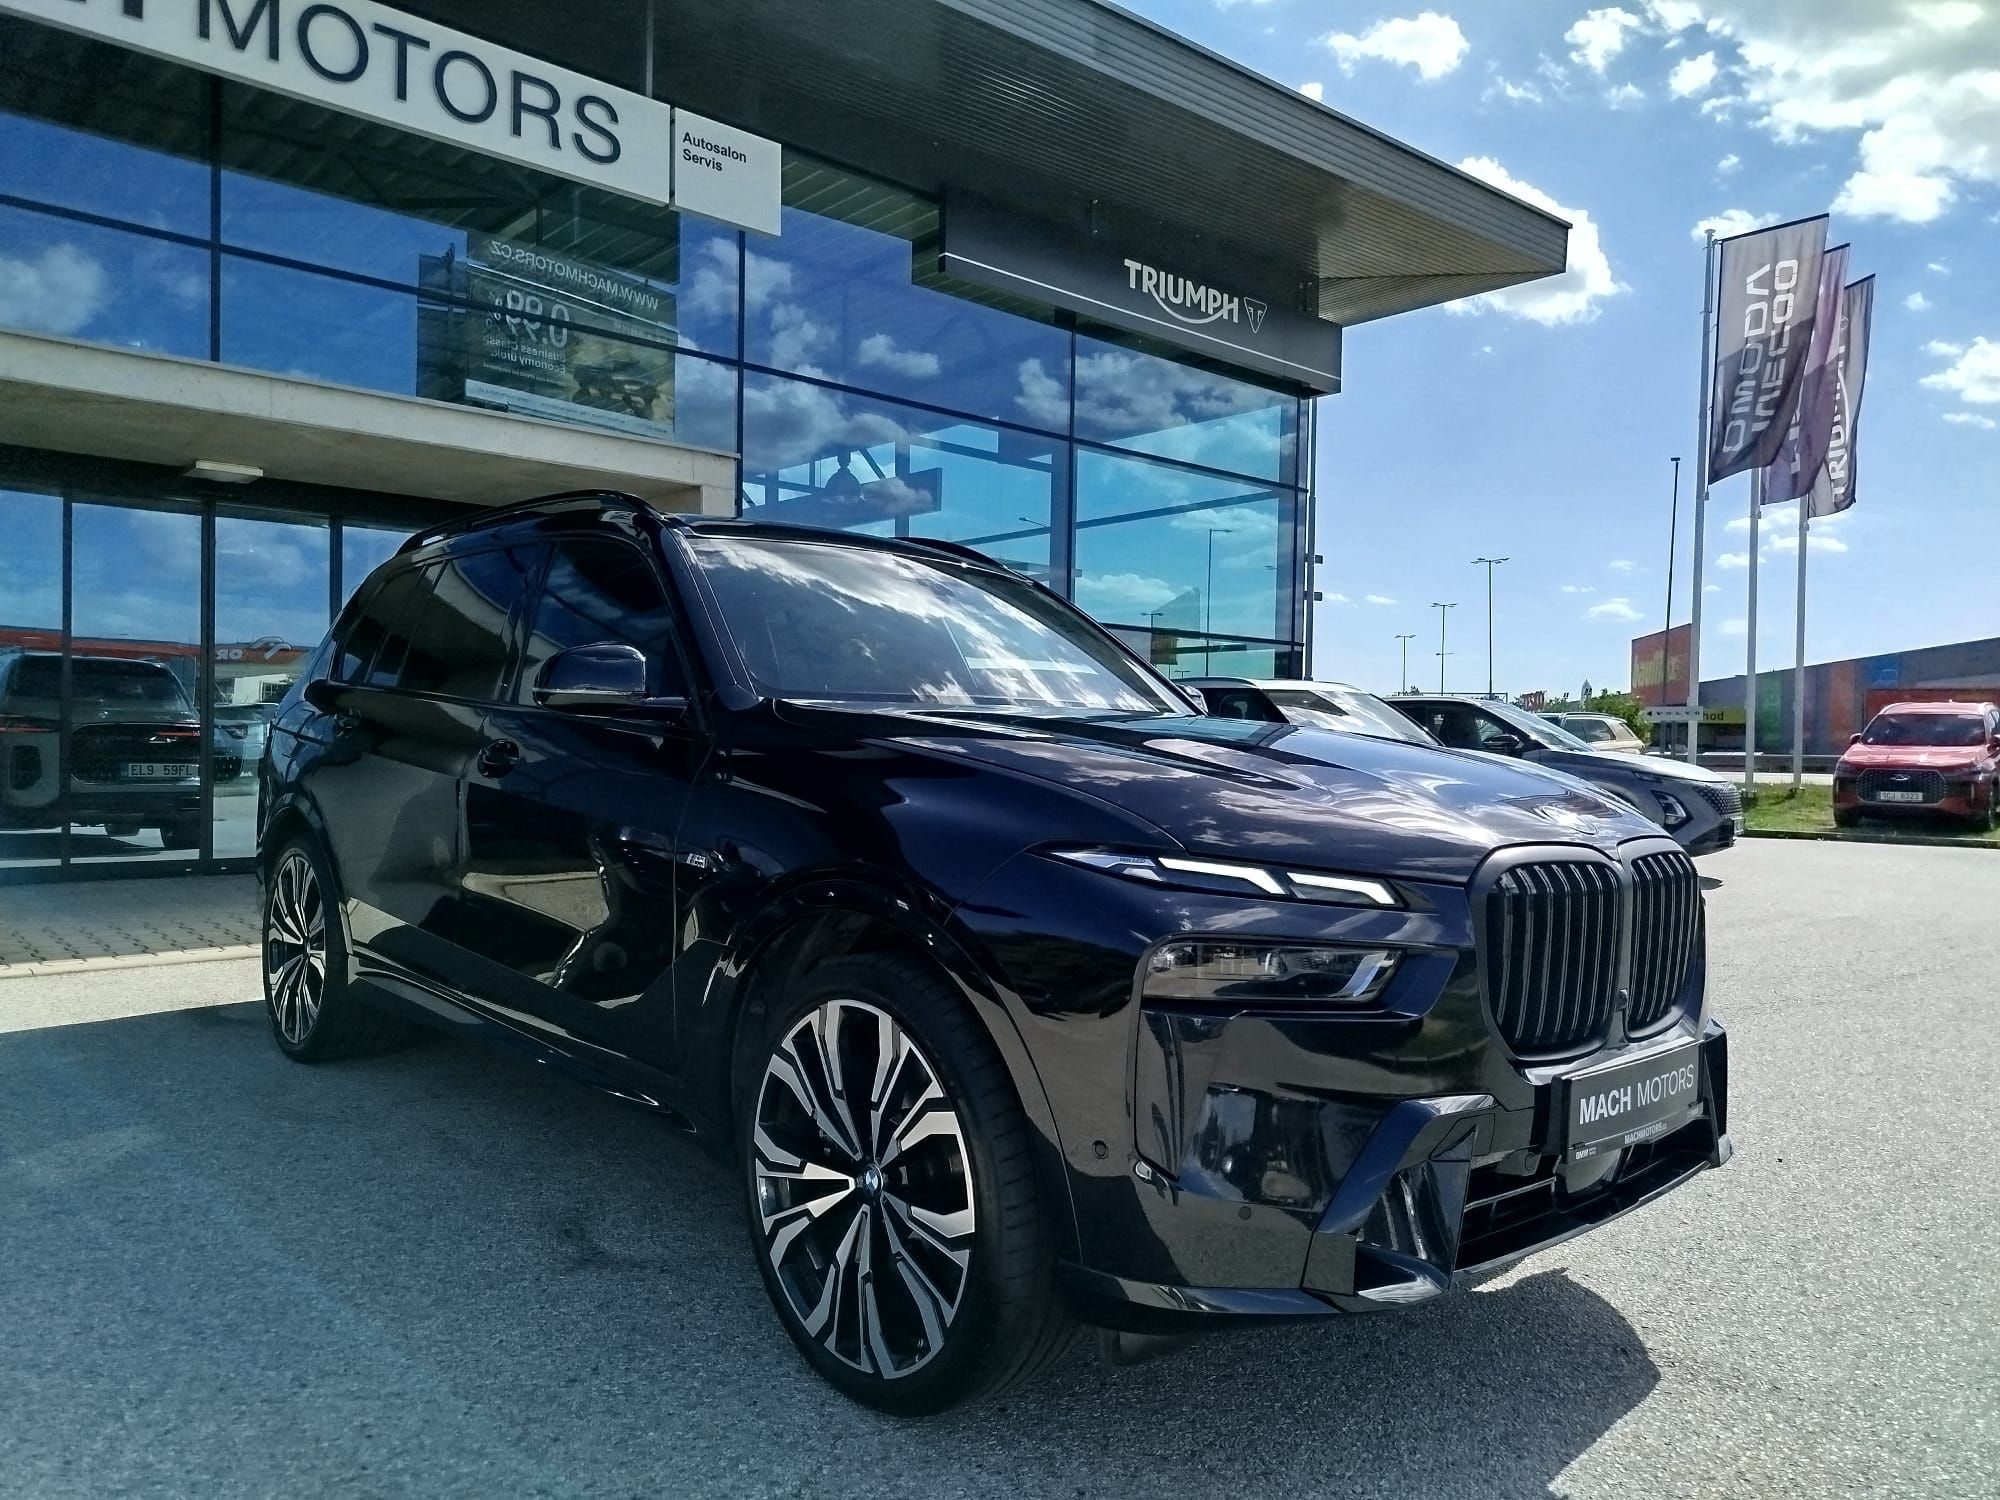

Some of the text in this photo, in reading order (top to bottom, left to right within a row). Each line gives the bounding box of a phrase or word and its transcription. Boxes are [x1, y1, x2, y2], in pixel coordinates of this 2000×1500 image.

[197, 0, 622, 165] MOTORS
[682, 131, 747, 163] Autosalon
[682, 148, 723, 172] Servis
[1123, 258, 1239, 324] TRIUMPH
[1722, 262, 1771, 453] OMODA
[1829, 344, 1851, 503] TRIU
[131, 764, 154, 776] EL9
[163, 764, 193, 776] 59FL
[1579, 1064, 1695, 1125] MACH MOTORS
